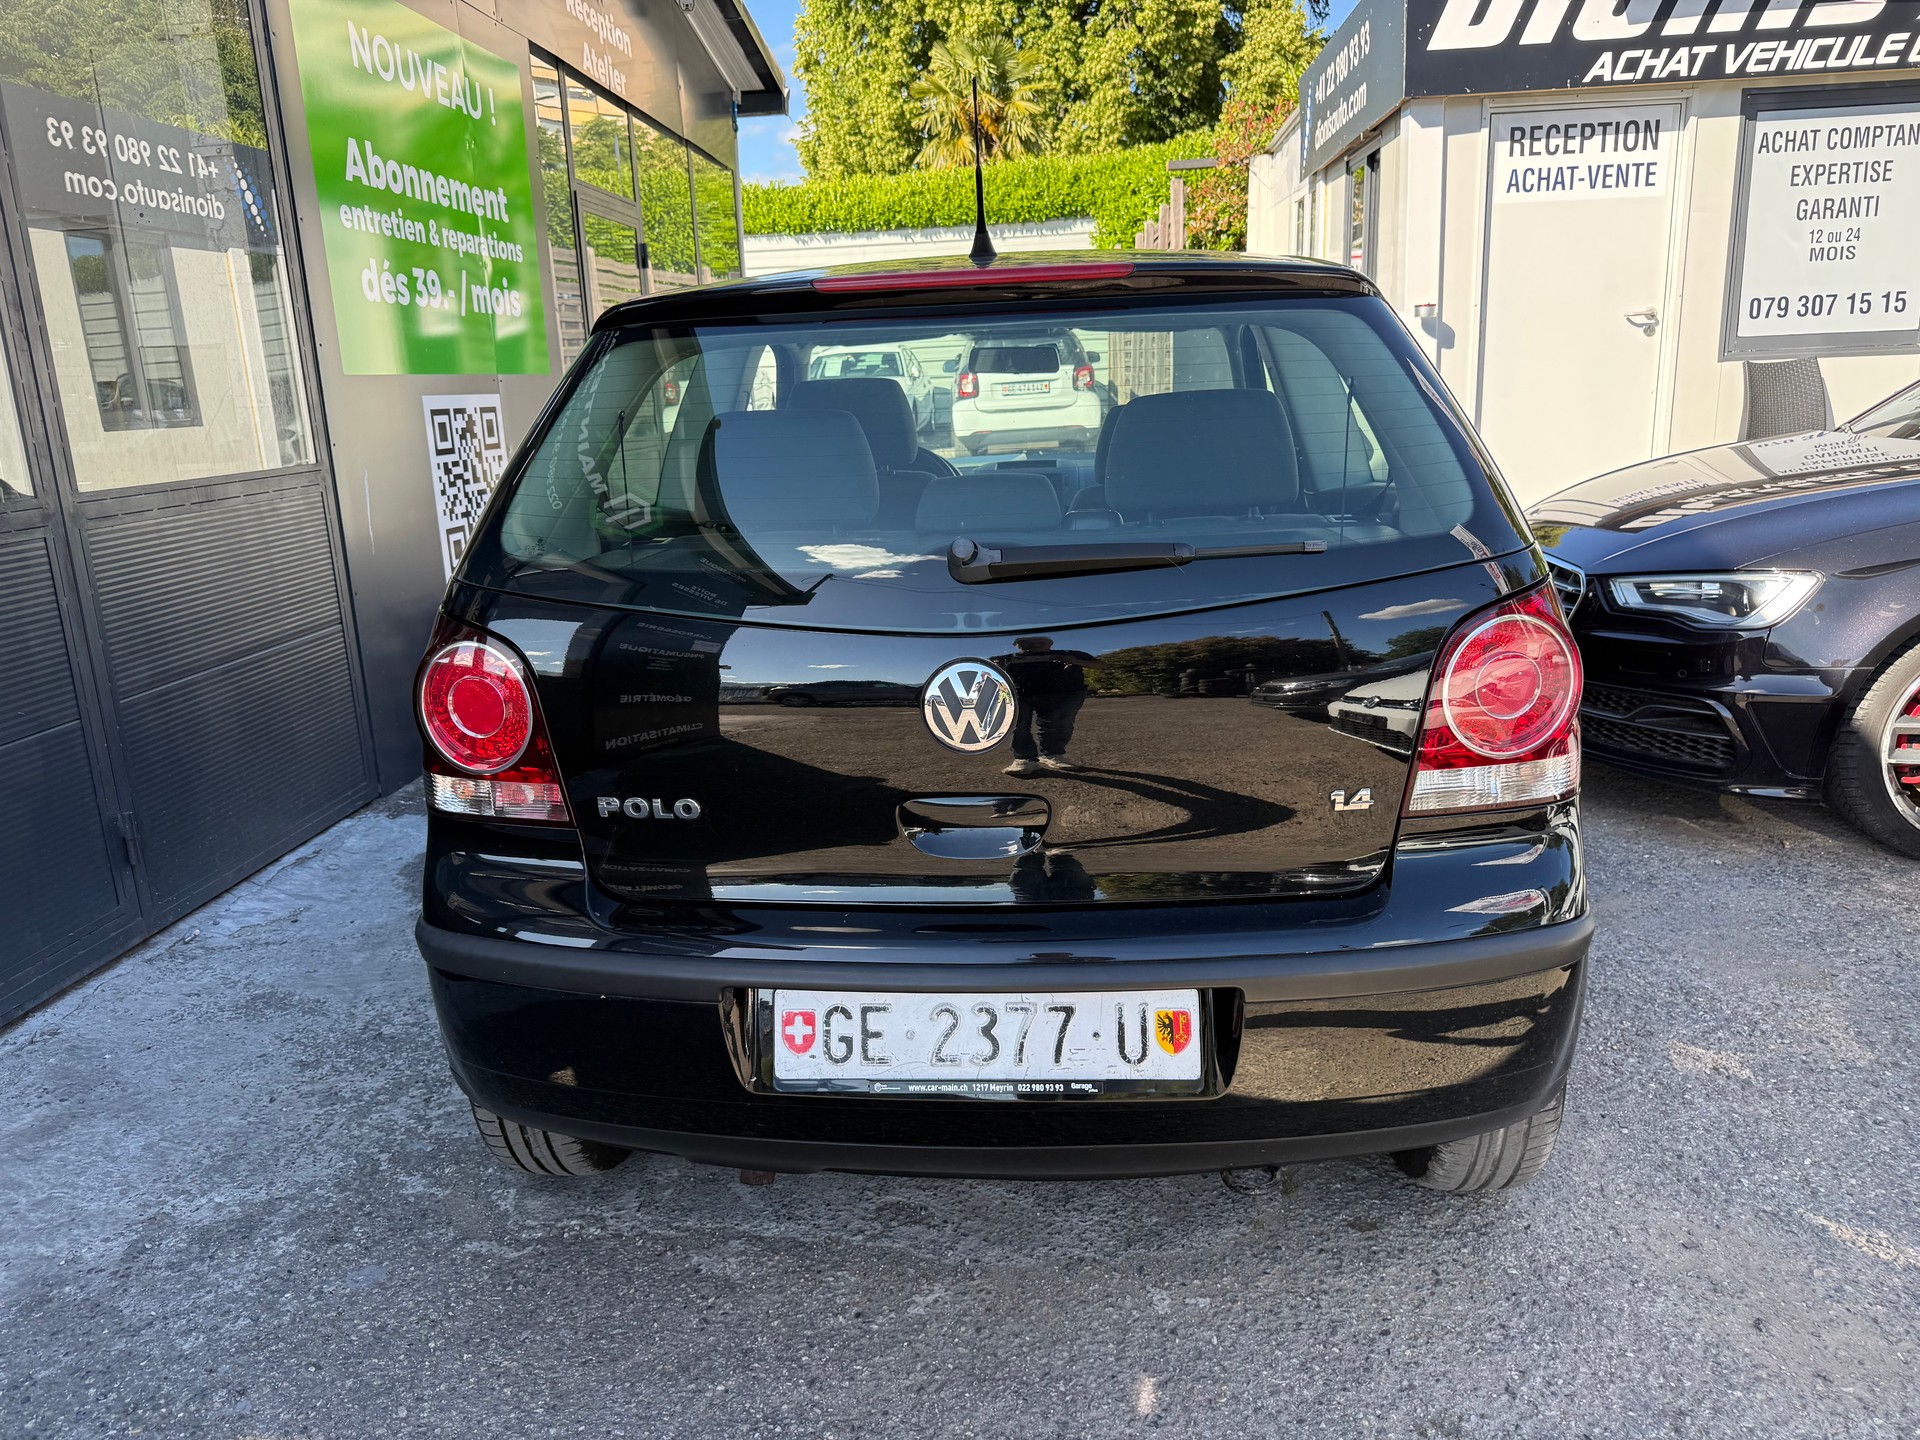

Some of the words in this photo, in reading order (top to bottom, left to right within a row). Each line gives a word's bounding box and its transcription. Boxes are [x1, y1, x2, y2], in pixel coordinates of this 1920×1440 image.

[348, 20, 482, 120] NOUVEAU
[488, 87, 496, 126] !
[583, 41, 626, 95] Atelier
[1315, 72, 1326, 104] +41
[1326, 62, 1335, 96] 22
[1335, 45, 1348, 87] 980
[1349, 33, 1359, 71] 93
[1360, 20, 1370, 59] 93
[1582, 45, 1718, 83] ACHAT
[1724, 32, 1912, 75] VEHICULE
[1314, 81, 1367, 150] dionisauto.com
[1509, 118, 1661, 158] RECEPTION
[1757, 128, 1821, 154] ACHAT
[345, 137, 510, 223] Abonnement
[1506, 162, 1657, 194] ACHAT-VENTE
[1790, 160, 1894, 187] EXPERTISE
[1796, 195, 1880, 221] GARANTI
[339, 204, 426, 244] entretien
[428, 219, 440, 247] &
[441, 226, 524, 263] reparations
[1808, 229, 1823, 244] 12
[1827, 230, 1841, 243] ou
[1845, 227, 1861, 242] 24
[1809, 245, 1856, 262] MOIS
[361, 258, 410, 306] dés
[412, 267, 455, 310] 39.-
[461, 270, 467, 316] /
[471, 277, 521, 318] mois
[1749, 296, 1789, 320] 079
[1796, 294, 1838, 318] 307
[1846, 292, 1872, 315] 15
[1881, 290, 1907, 313] 15
[597, 796, 701, 819] POLO
[823, 1002, 893, 1067] GE
[930, 1001, 1077, 1067] 2377
[1114, 1001, 1150, 1066] U
[908, 1083, 968, 1092] www.car-main.ch
[972, 1083, 988, 1092] 1217
[990, 1083, 1014, 1093] Meyrin
[1017, 1083, 1030, 1092] 022
[1031, 1083, 1044, 1092] 980
[1045, 1083, 1054, 1092] 93
[1055, 1083, 1064, 1092] 93
[1070, 1082, 1093, 1091] Garage
